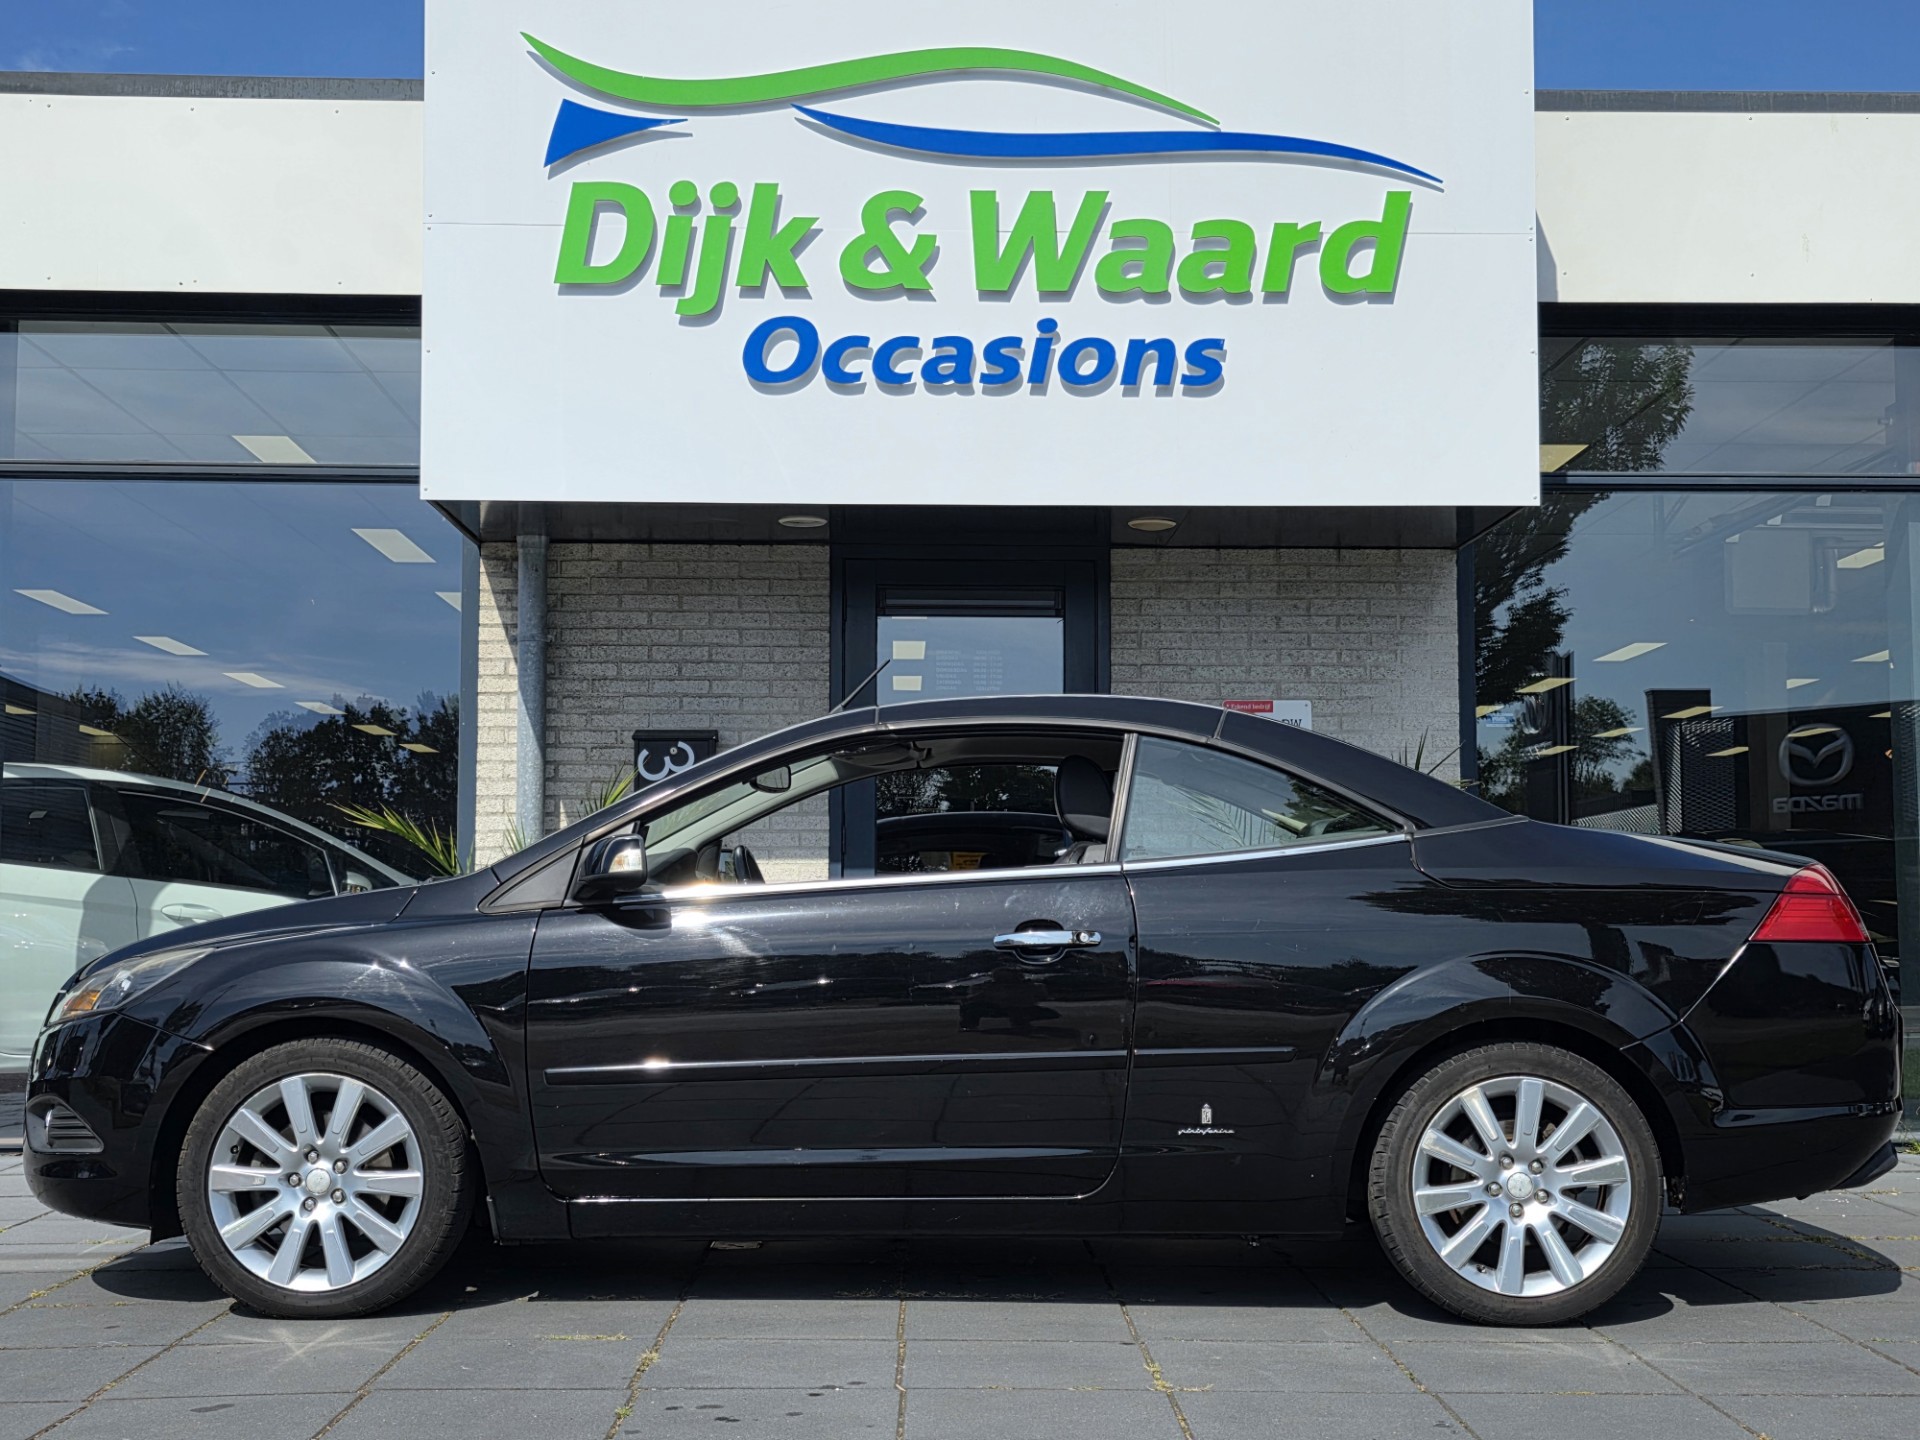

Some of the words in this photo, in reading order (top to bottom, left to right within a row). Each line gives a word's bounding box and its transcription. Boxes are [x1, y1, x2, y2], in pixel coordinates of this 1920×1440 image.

[554, 182, 819, 317] Dijk
[840, 191, 936, 292] &
[970, 190, 1411, 293] Waard
[744, 316, 1227, 387] Occasions
